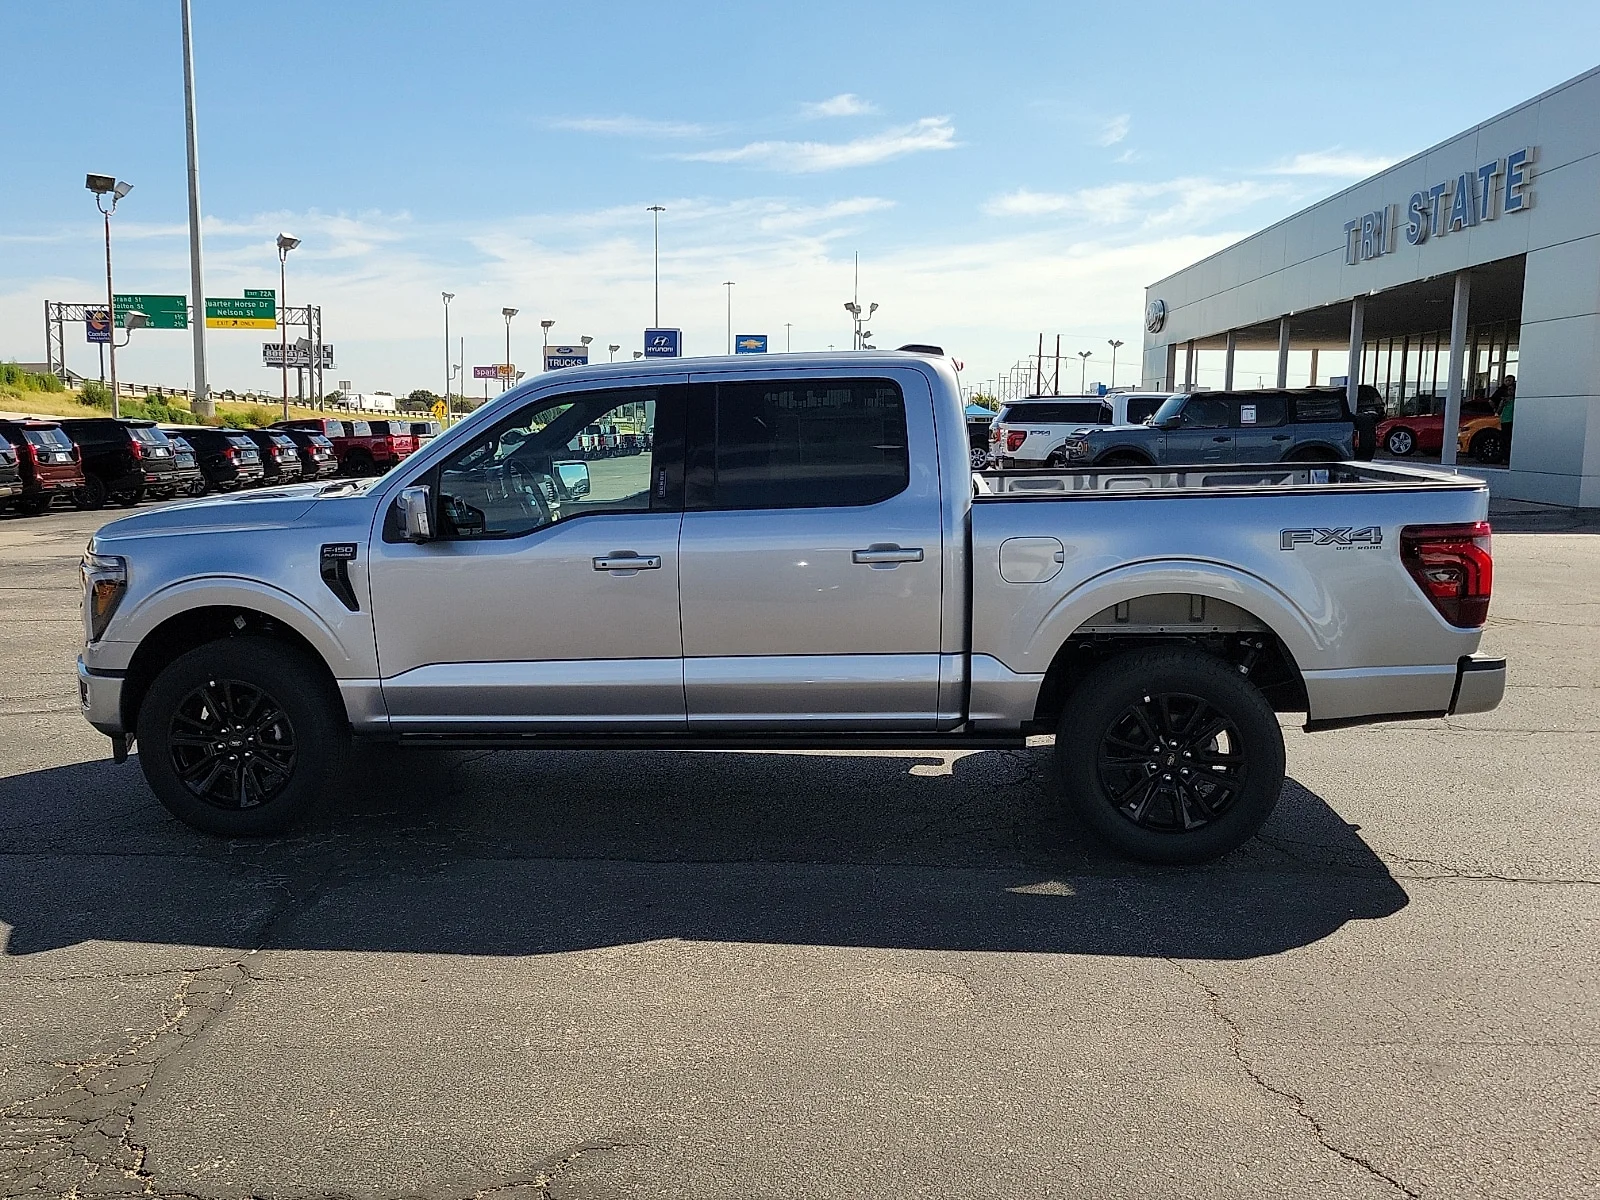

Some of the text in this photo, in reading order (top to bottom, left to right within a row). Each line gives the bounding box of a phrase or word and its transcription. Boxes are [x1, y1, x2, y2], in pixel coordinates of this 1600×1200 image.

[1344, 145, 1534, 265] TRI STATE
[548, 358, 583, 367] TRUCKS
[475, 367, 496, 377] spark
[1279, 526, 1383, 551] FX4
